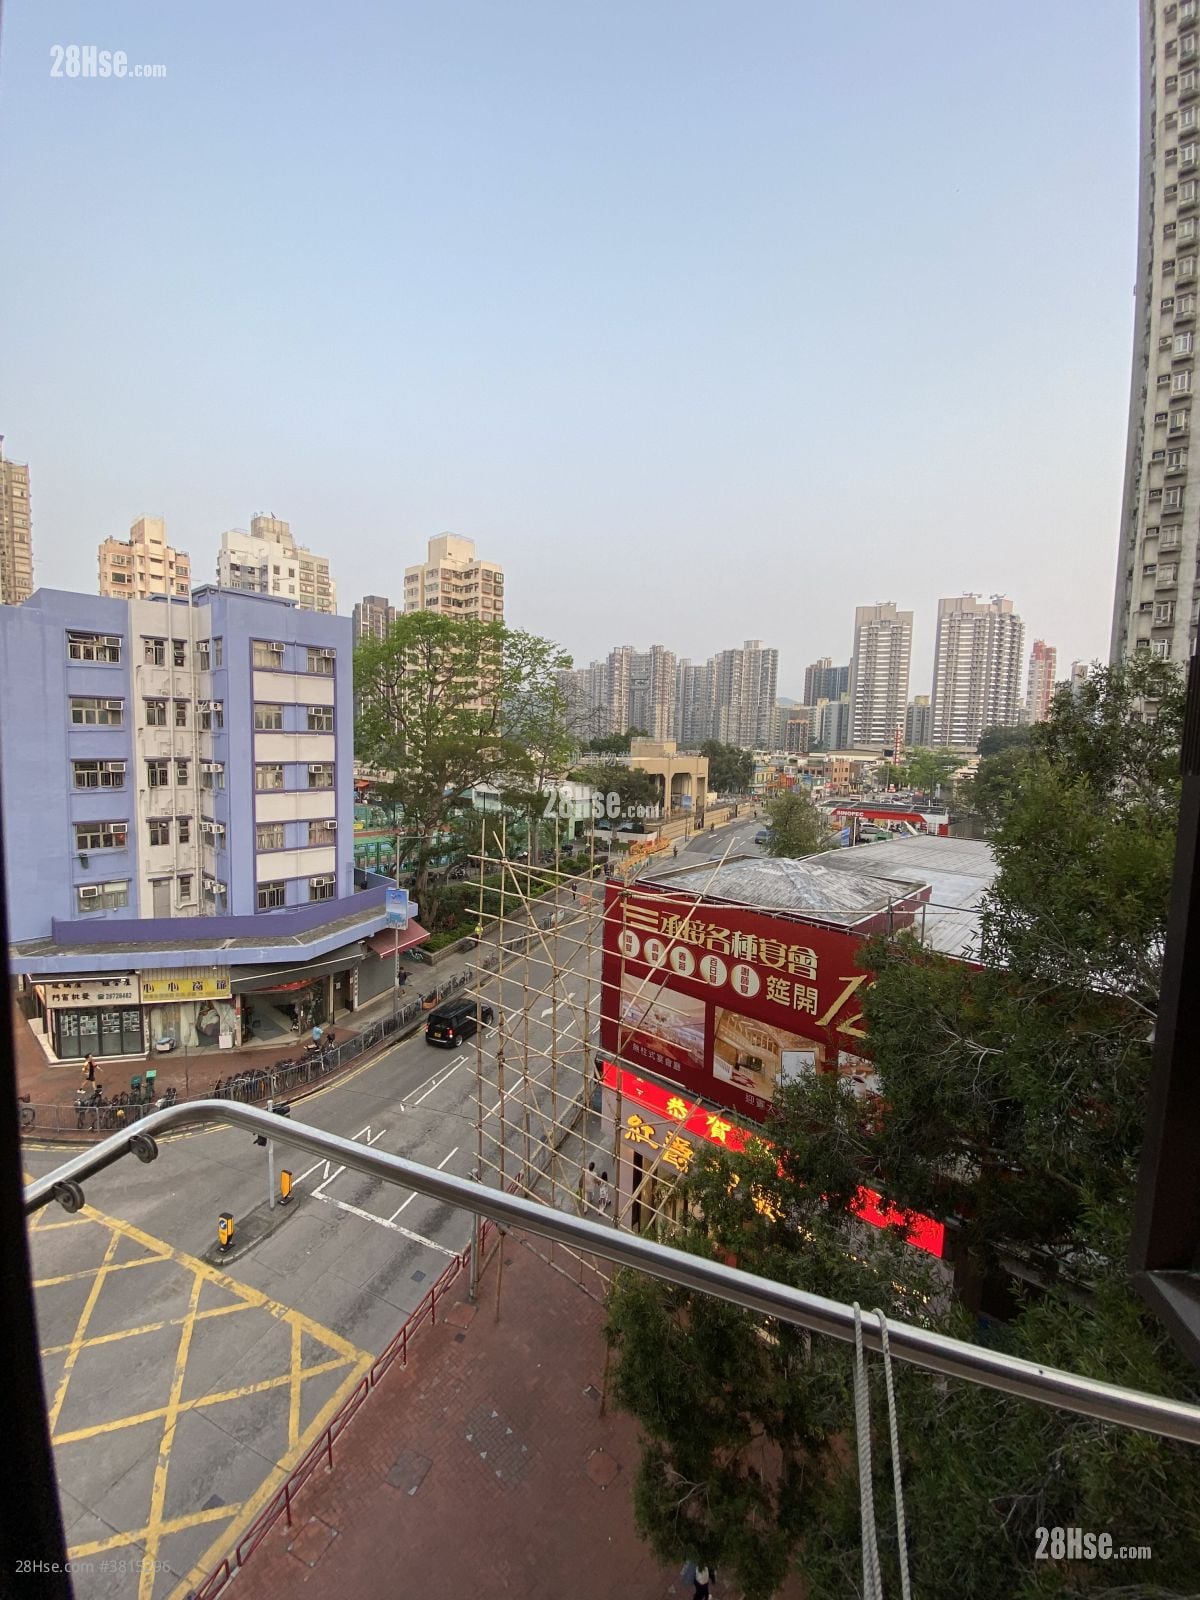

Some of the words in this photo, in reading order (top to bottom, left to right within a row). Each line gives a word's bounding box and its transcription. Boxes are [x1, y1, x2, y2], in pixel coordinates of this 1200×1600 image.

[660, 909, 819, 981] 承接各種宴會
[766, 975, 819, 1016] 筵開
